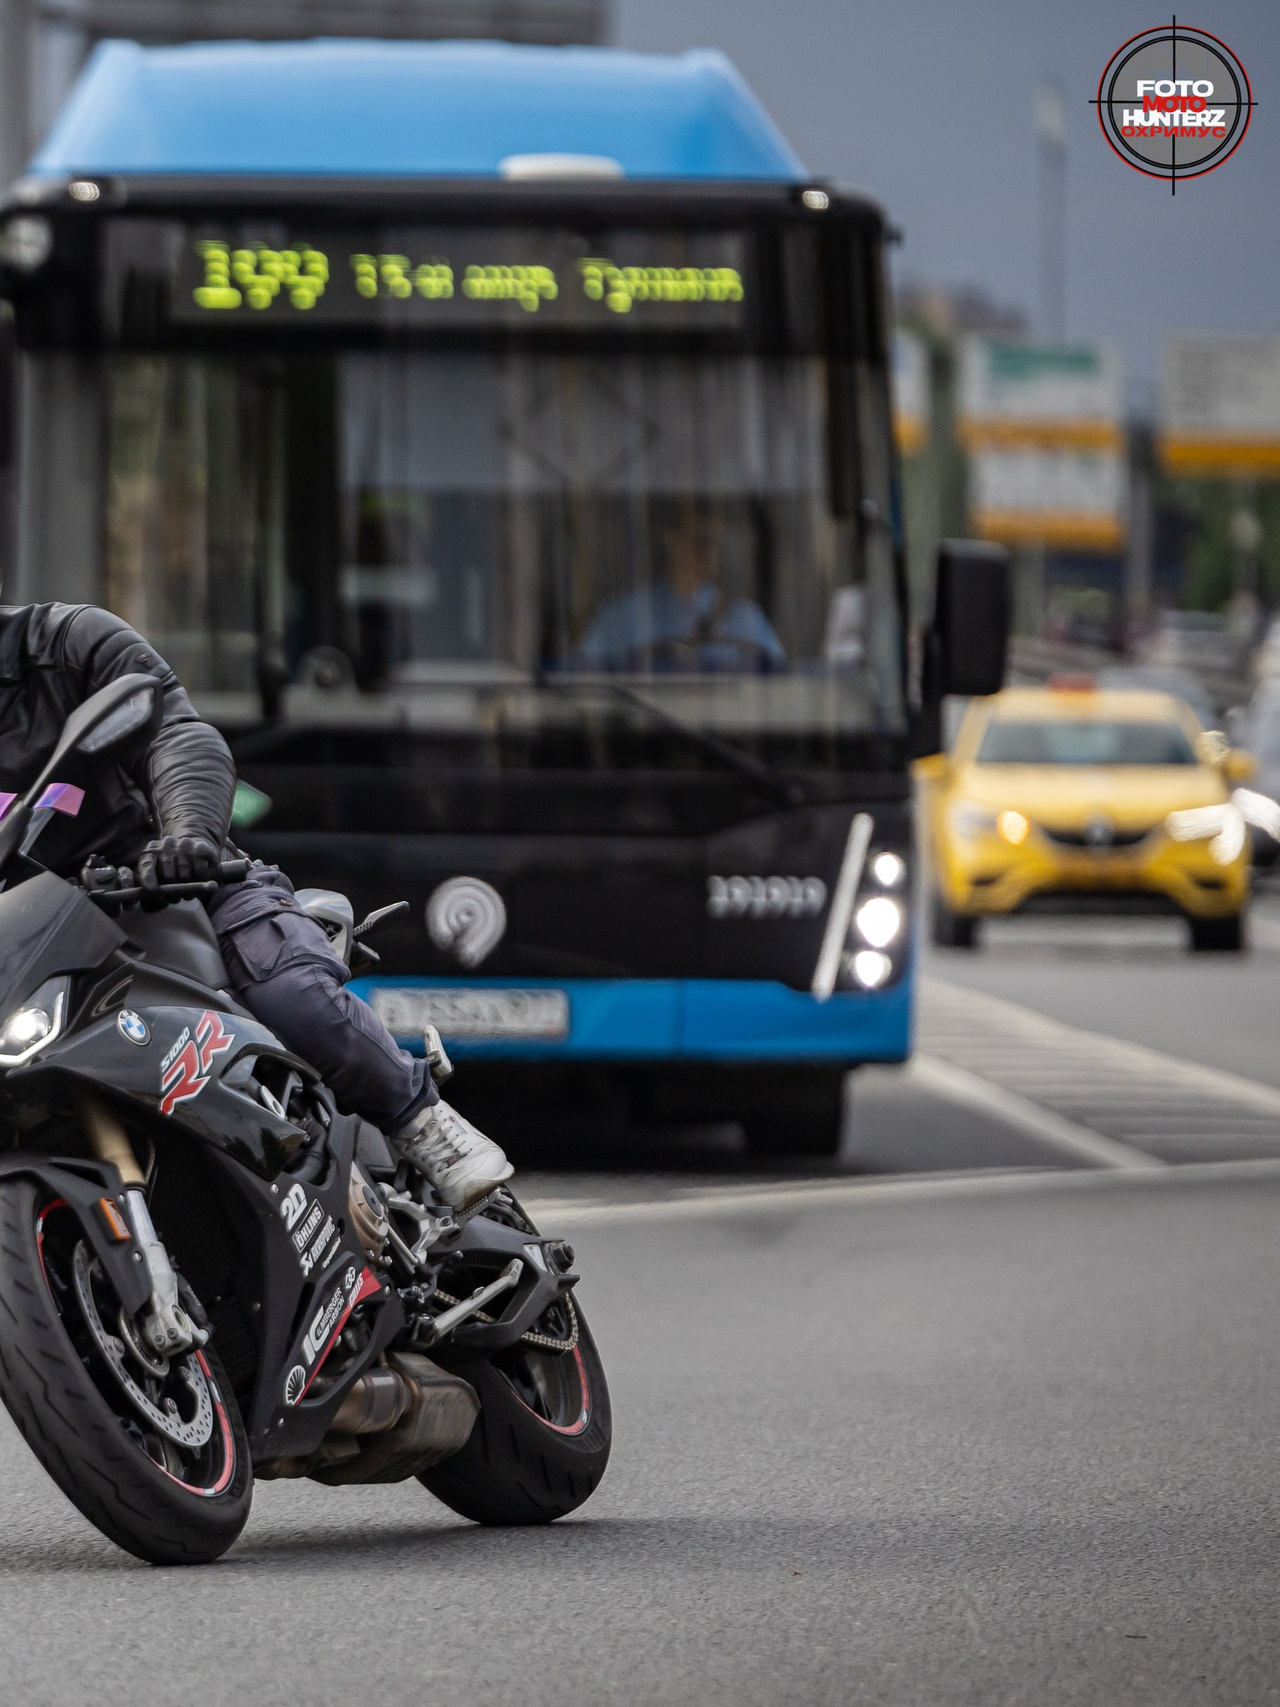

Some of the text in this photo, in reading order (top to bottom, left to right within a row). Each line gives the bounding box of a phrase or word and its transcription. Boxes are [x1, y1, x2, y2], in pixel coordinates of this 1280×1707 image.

[160, 1010, 236, 1115] RR
[161, 1027, 190, 1073] S1000
[294, 1206, 322, 1248] ÖHLINS
